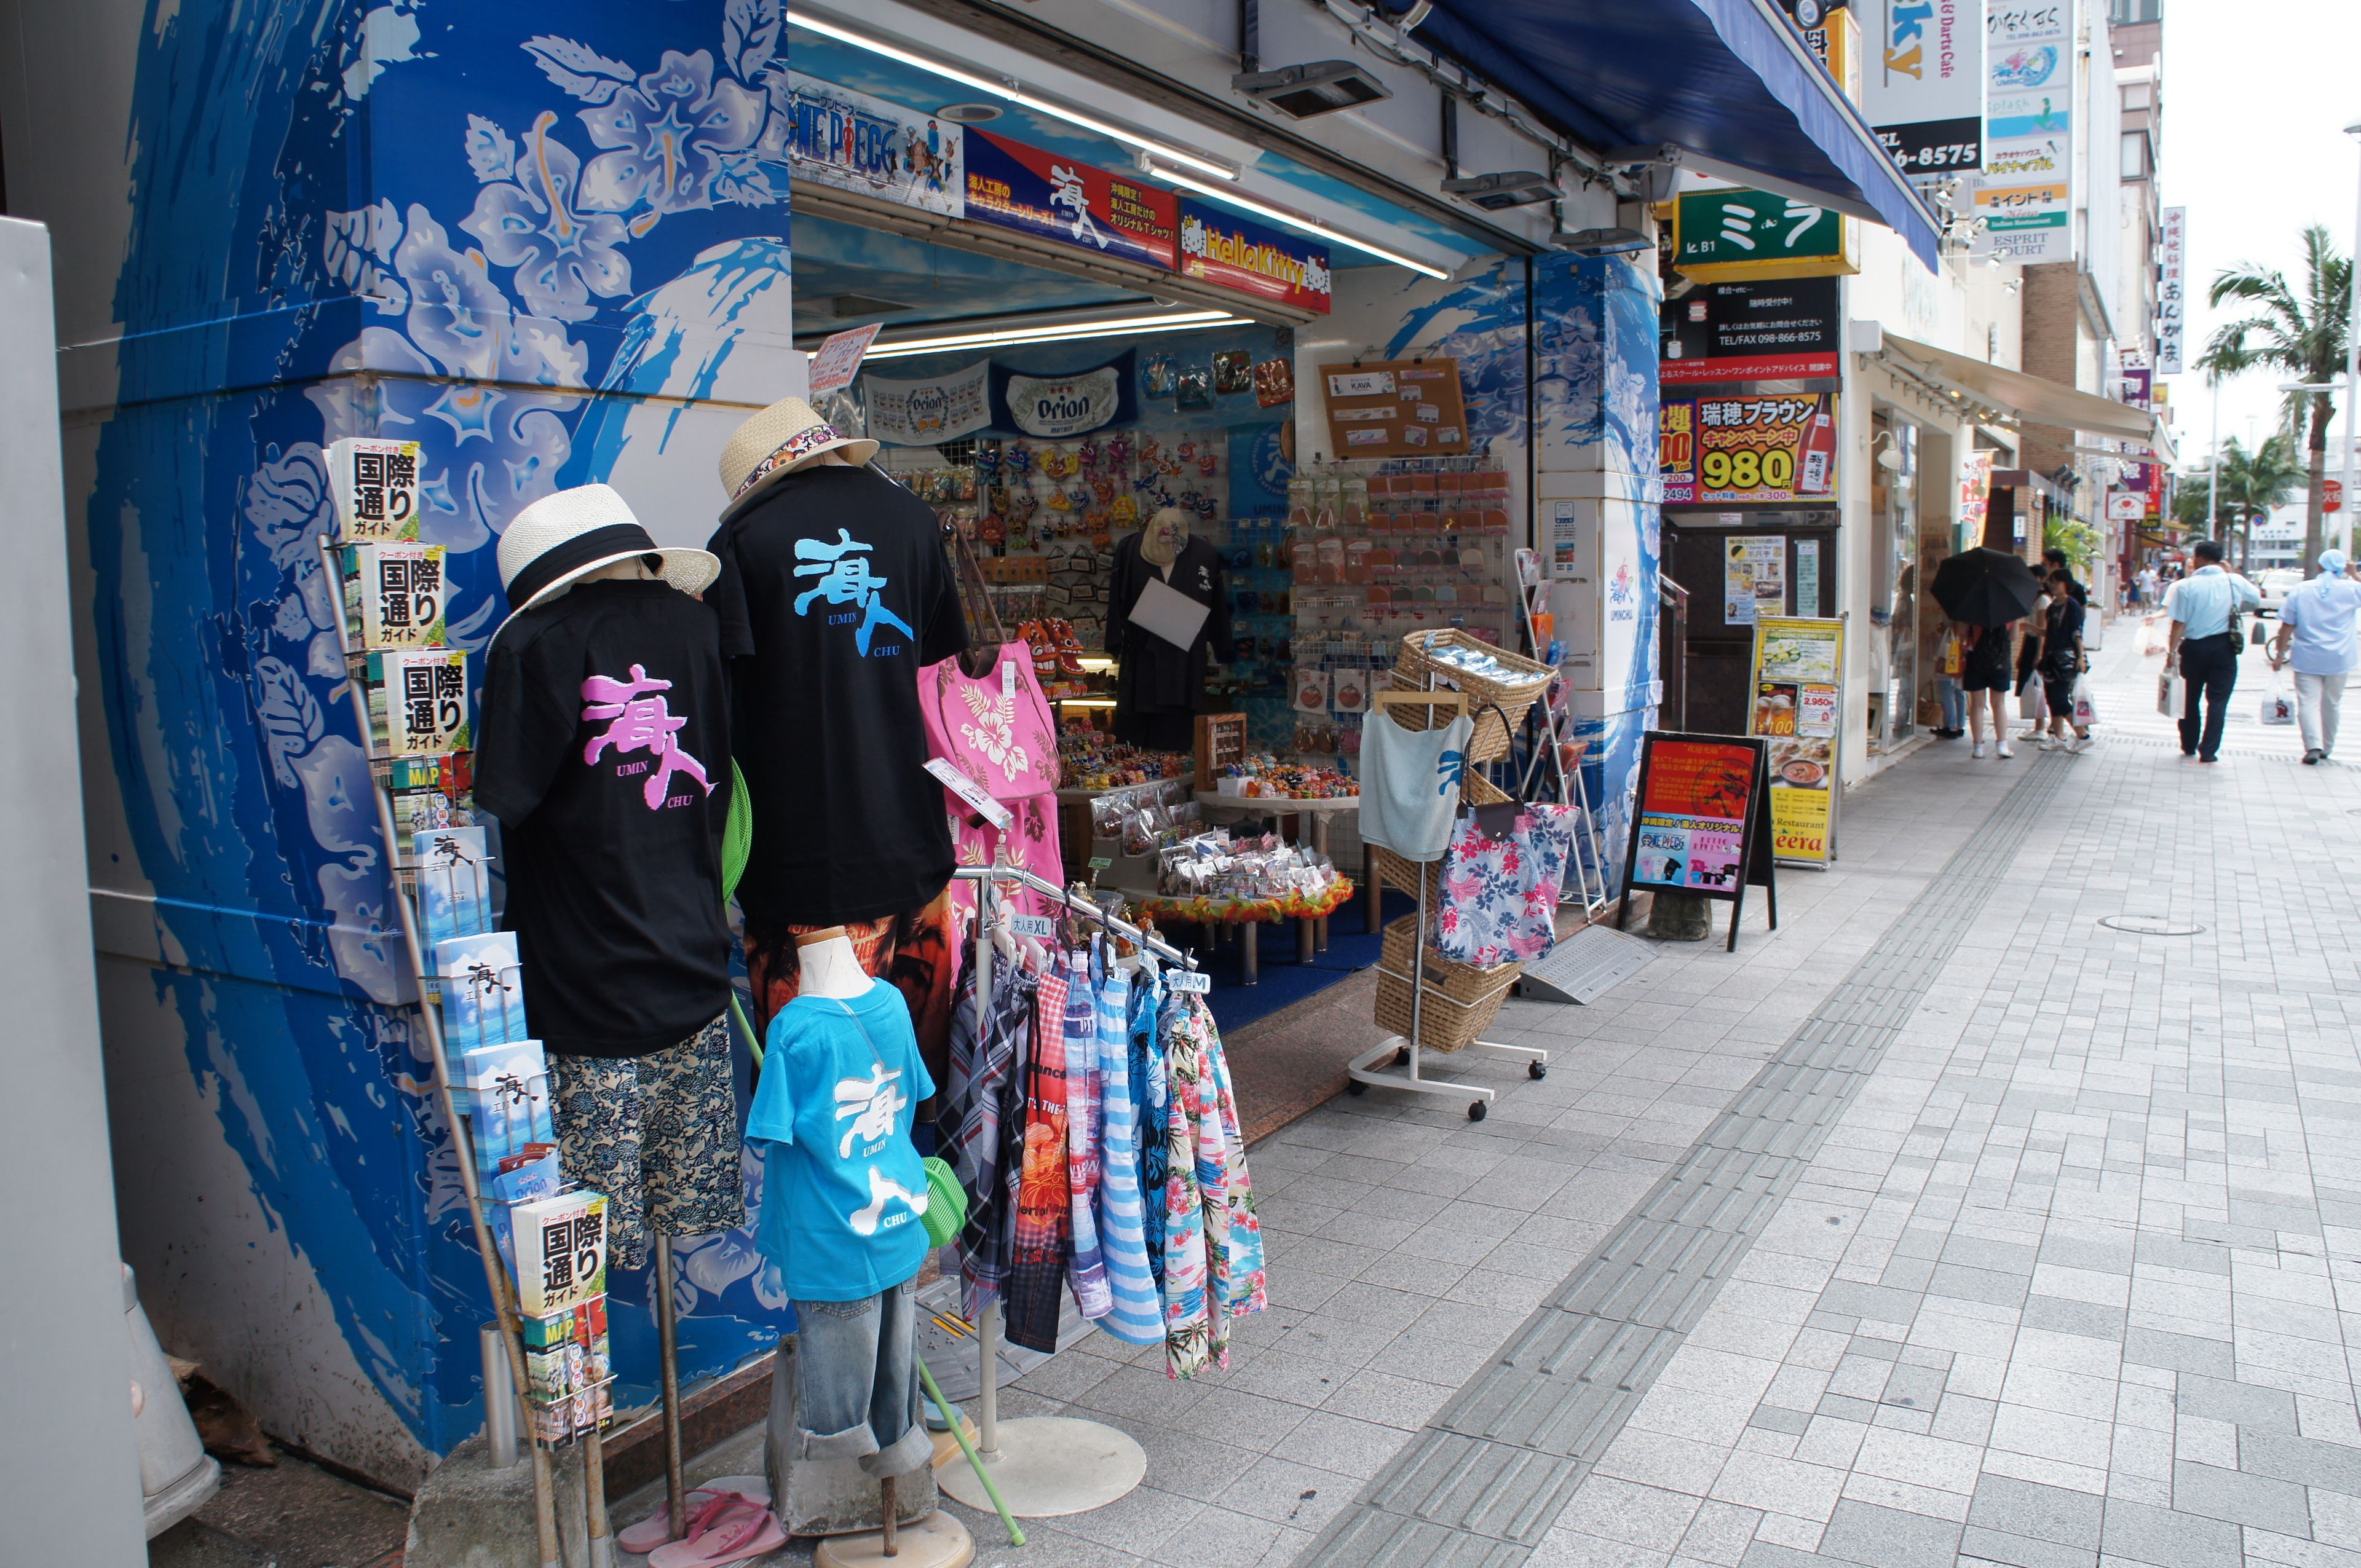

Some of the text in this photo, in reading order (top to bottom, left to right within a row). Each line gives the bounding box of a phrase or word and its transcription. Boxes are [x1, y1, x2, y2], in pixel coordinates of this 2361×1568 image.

[1883, 0, 1933, 81] ky
[820, 96, 855, 116] ワンピース
[969, 174, 1011, 199] 海人工房の
[1110, 197, 1156, 221] 海人工房だけの
[1700, 241, 1715, 253] B1
[1993, 233, 2048, 246] ESPRIT
[2162, 281, 2182, 363] あんがま
[1719, 331, 1821, 346] TEL/FAX 098-866-8575
[1038, 395, 1090, 420] Orion
[1702, 401, 1814, 427] 瑞穂ブラウン
[1702, 427, 1800, 447] キャンペーン中
[354, 443, 400, 454] クーポン付き
[354, 521, 391, 536] ガイド
[379, 551, 424, 559] クーポン付き
[828, 612, 856, 626] UMIN
[1610, 609, 1634, 622] UMINCHU
[381, 628, 417, 642] ガイド
[874, 645, 900, 658] CHU
[403, 657, 448, 666] クーポン付き
[406, 734, 443, 750] ガイド
[408, 767, 440, 786] MAP
[616, 760, 649, 778] UMIN
[667, 795, 694, 808] CHU
[1777, 818, 1825, 829] Restaurant
[1773, 835, 1822, 852] eera
[1042, 1099, 1061, 1115] THE
[863, 1137, 887, 1158] UMIN
[543, 1207, 588, 1226] クーポン付き
[883, 1211, 908, 1228] CHU
[543, 1285, 579, 1309] ガイド
[545, 1317, 575, 1345] MAP
